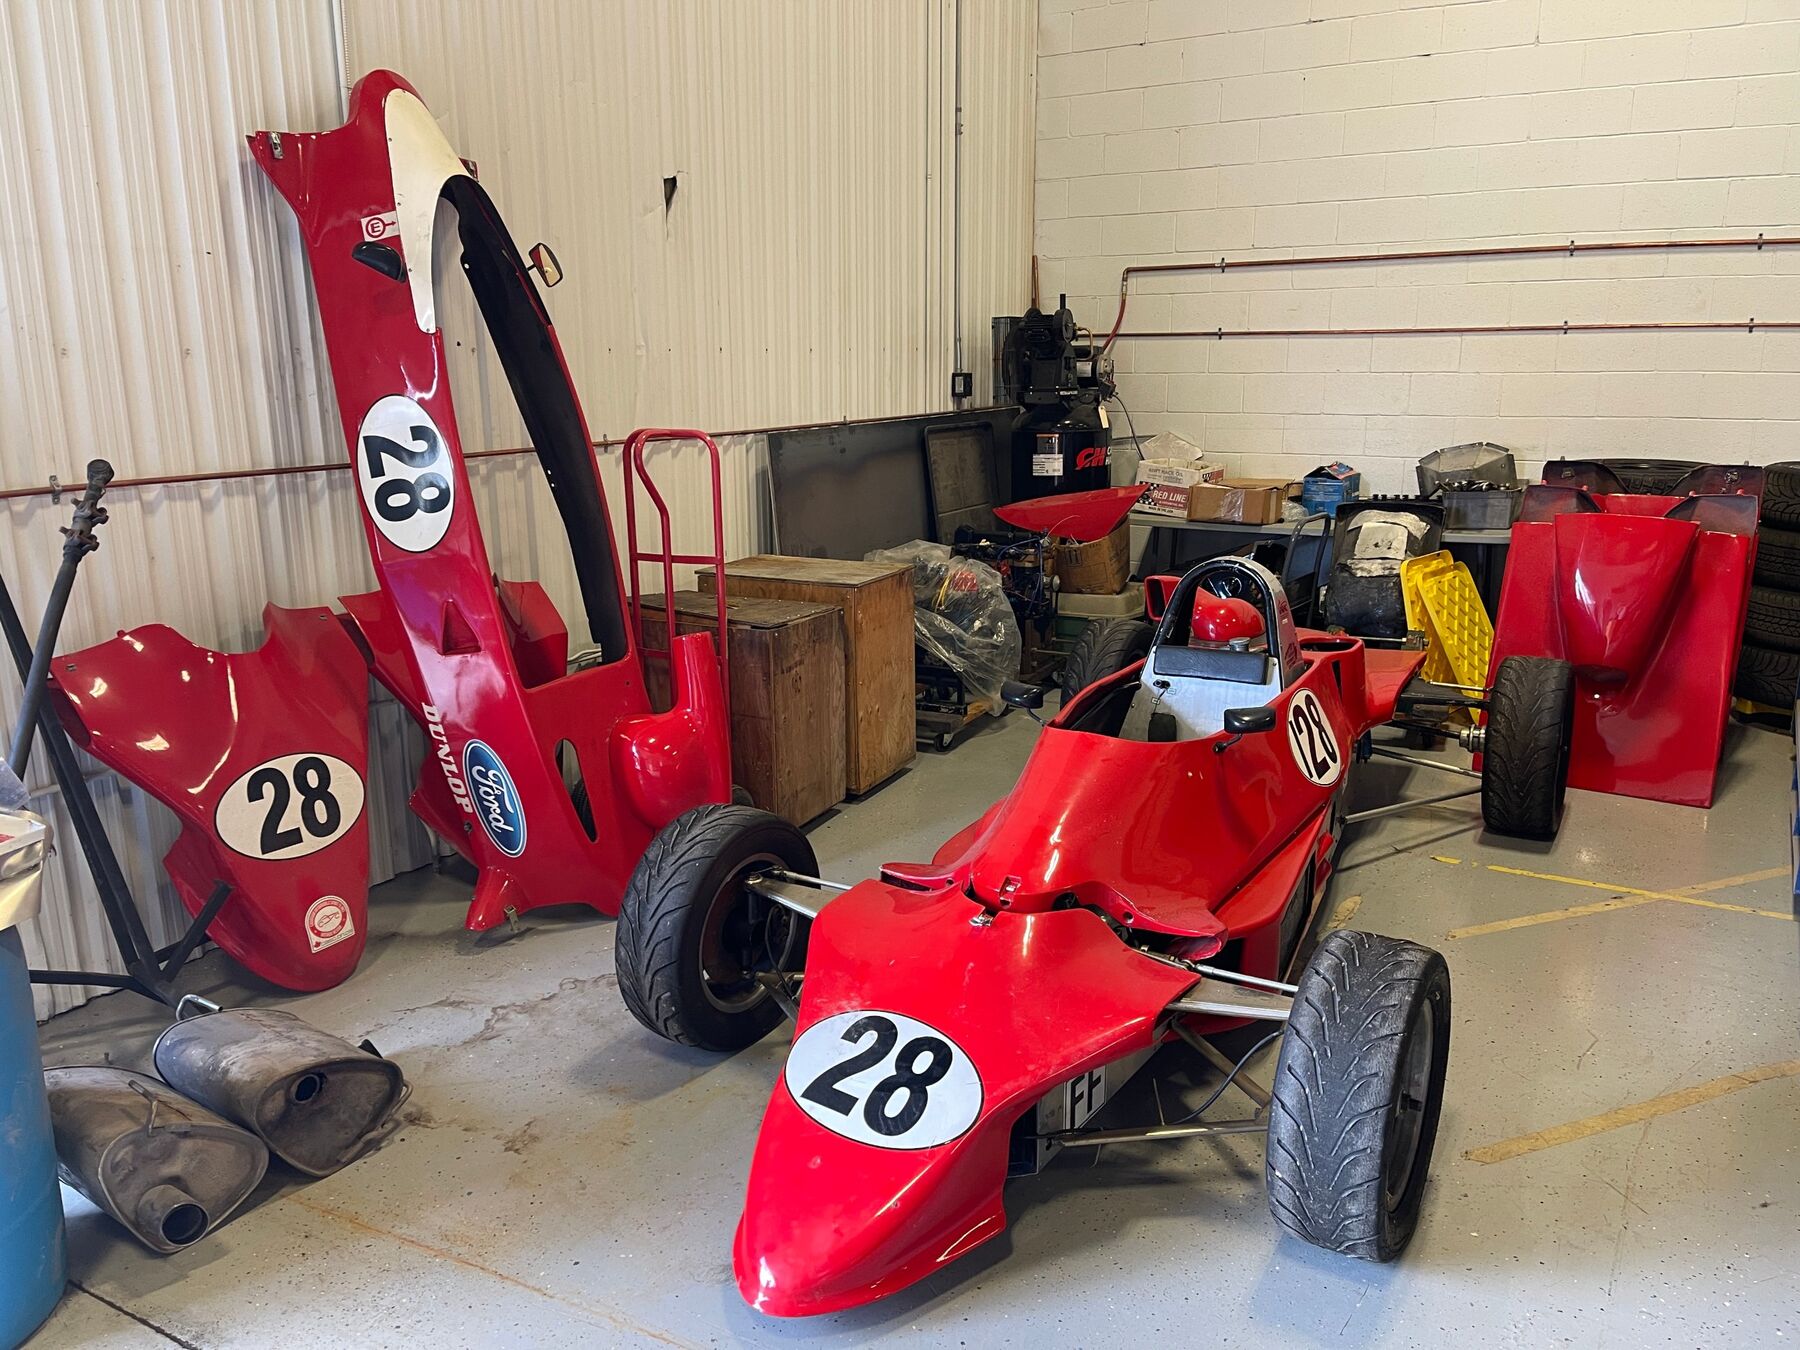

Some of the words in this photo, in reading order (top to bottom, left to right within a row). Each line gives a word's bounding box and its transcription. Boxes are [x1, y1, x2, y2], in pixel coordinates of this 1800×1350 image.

[370, 221, 382, 234] E
[362, 425, 451, 523] 28
[1152, 490, 1168, 500] RED
[1169, 492, 1187, 503] LINE
[247, 757, 341, 855] 28
[422, 702, 474, 813] DUNLOP
[472, 765, 514, 833] Ford
[800, 1015, 953, 1136] 28
